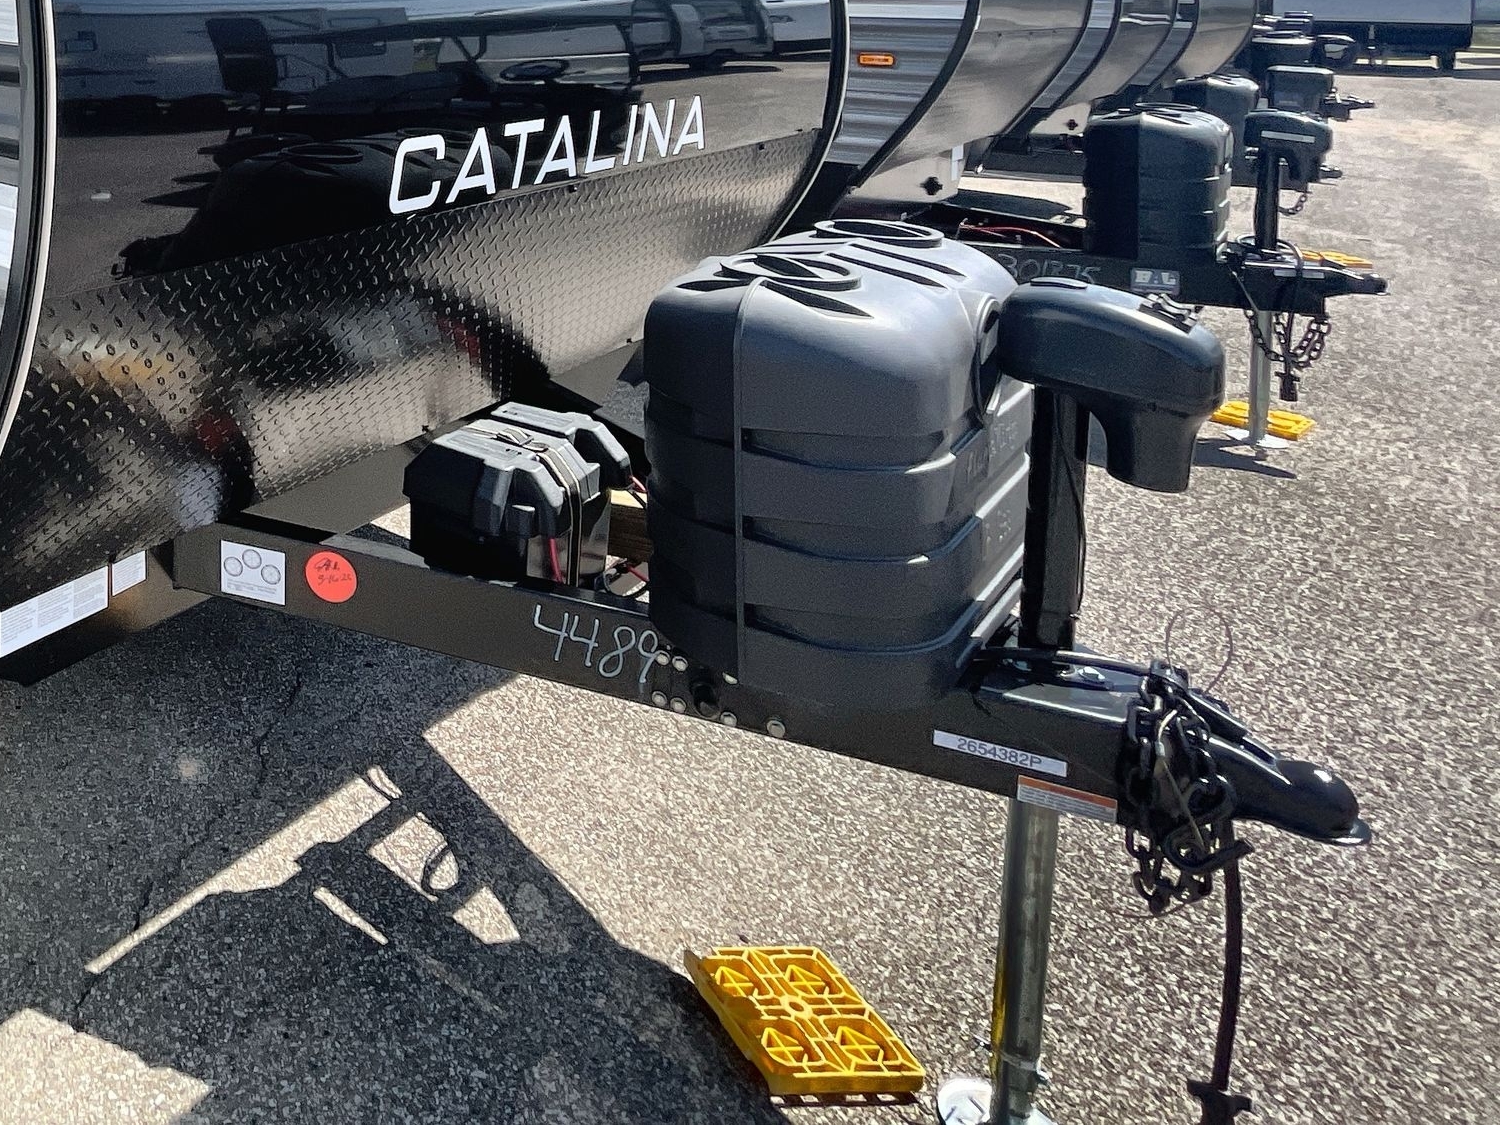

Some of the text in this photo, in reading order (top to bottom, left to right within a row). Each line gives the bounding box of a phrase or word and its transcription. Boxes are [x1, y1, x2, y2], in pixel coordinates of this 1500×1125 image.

[389, 94, 705, 215] CATALINA
[533, 604, 659, 684] 4489
[957, 738, 1042, 767] 2654382P
